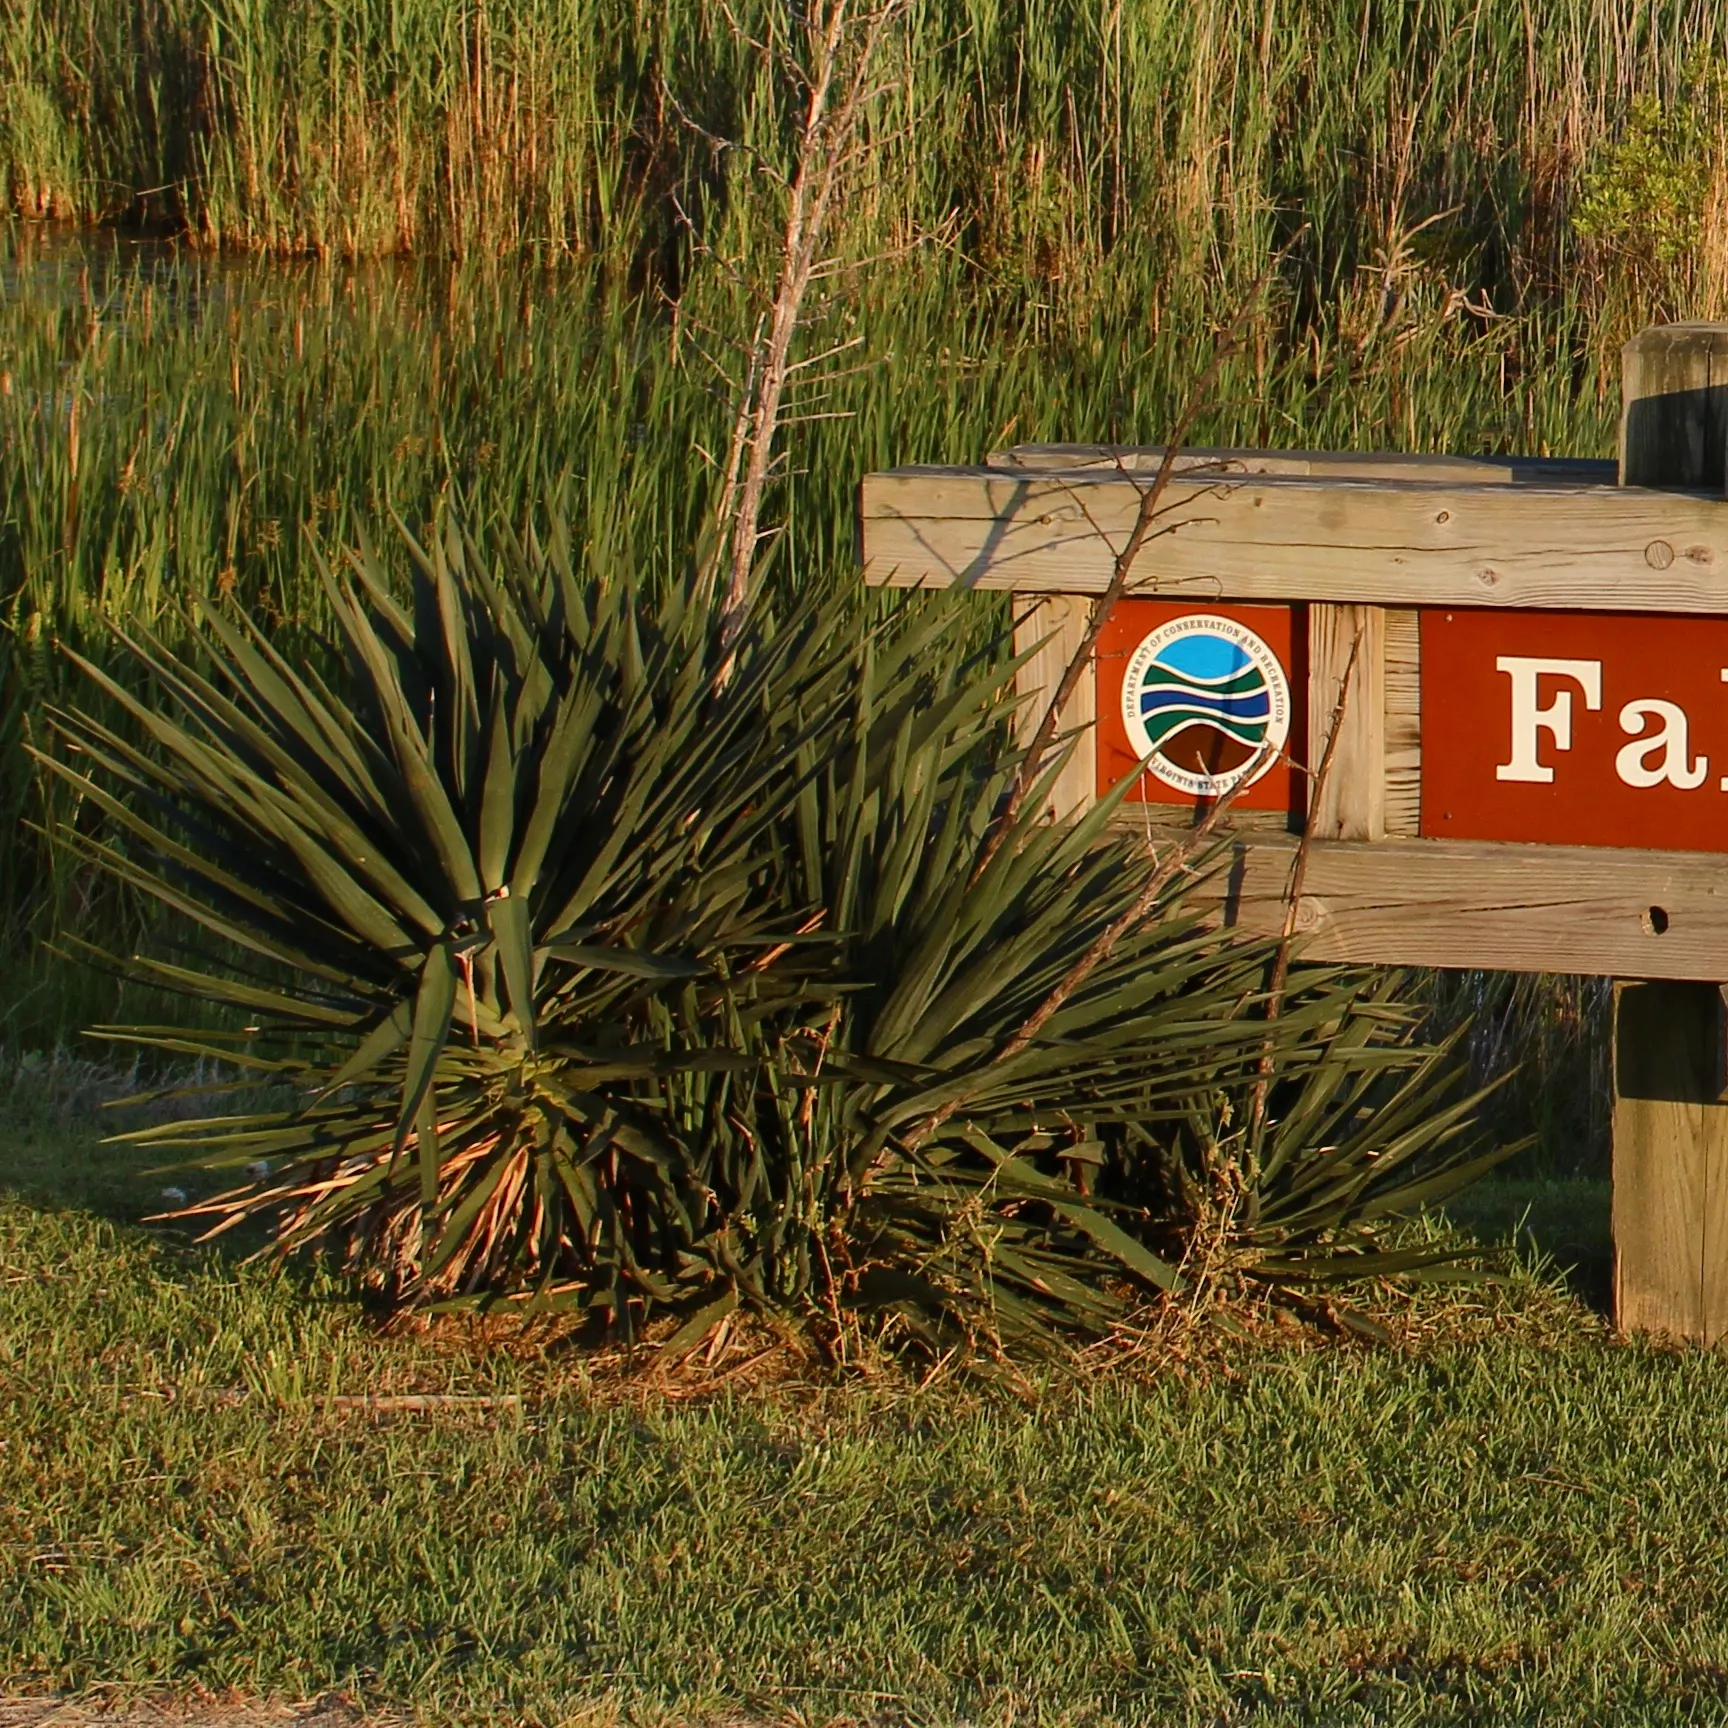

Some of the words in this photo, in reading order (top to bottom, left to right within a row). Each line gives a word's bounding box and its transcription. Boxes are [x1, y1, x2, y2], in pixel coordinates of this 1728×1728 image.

[1125, 645, 1151, 718] DEPARTMENT
[1149, 633, 1162, 648] OF
[1162, 619, 1242, 638] CONSERVATION
[1241, 635, 1261, 654] AND
[1259, 653, 1285, 724] RECREATION
[1151, 757, 1194, 788] VIRGINIA
